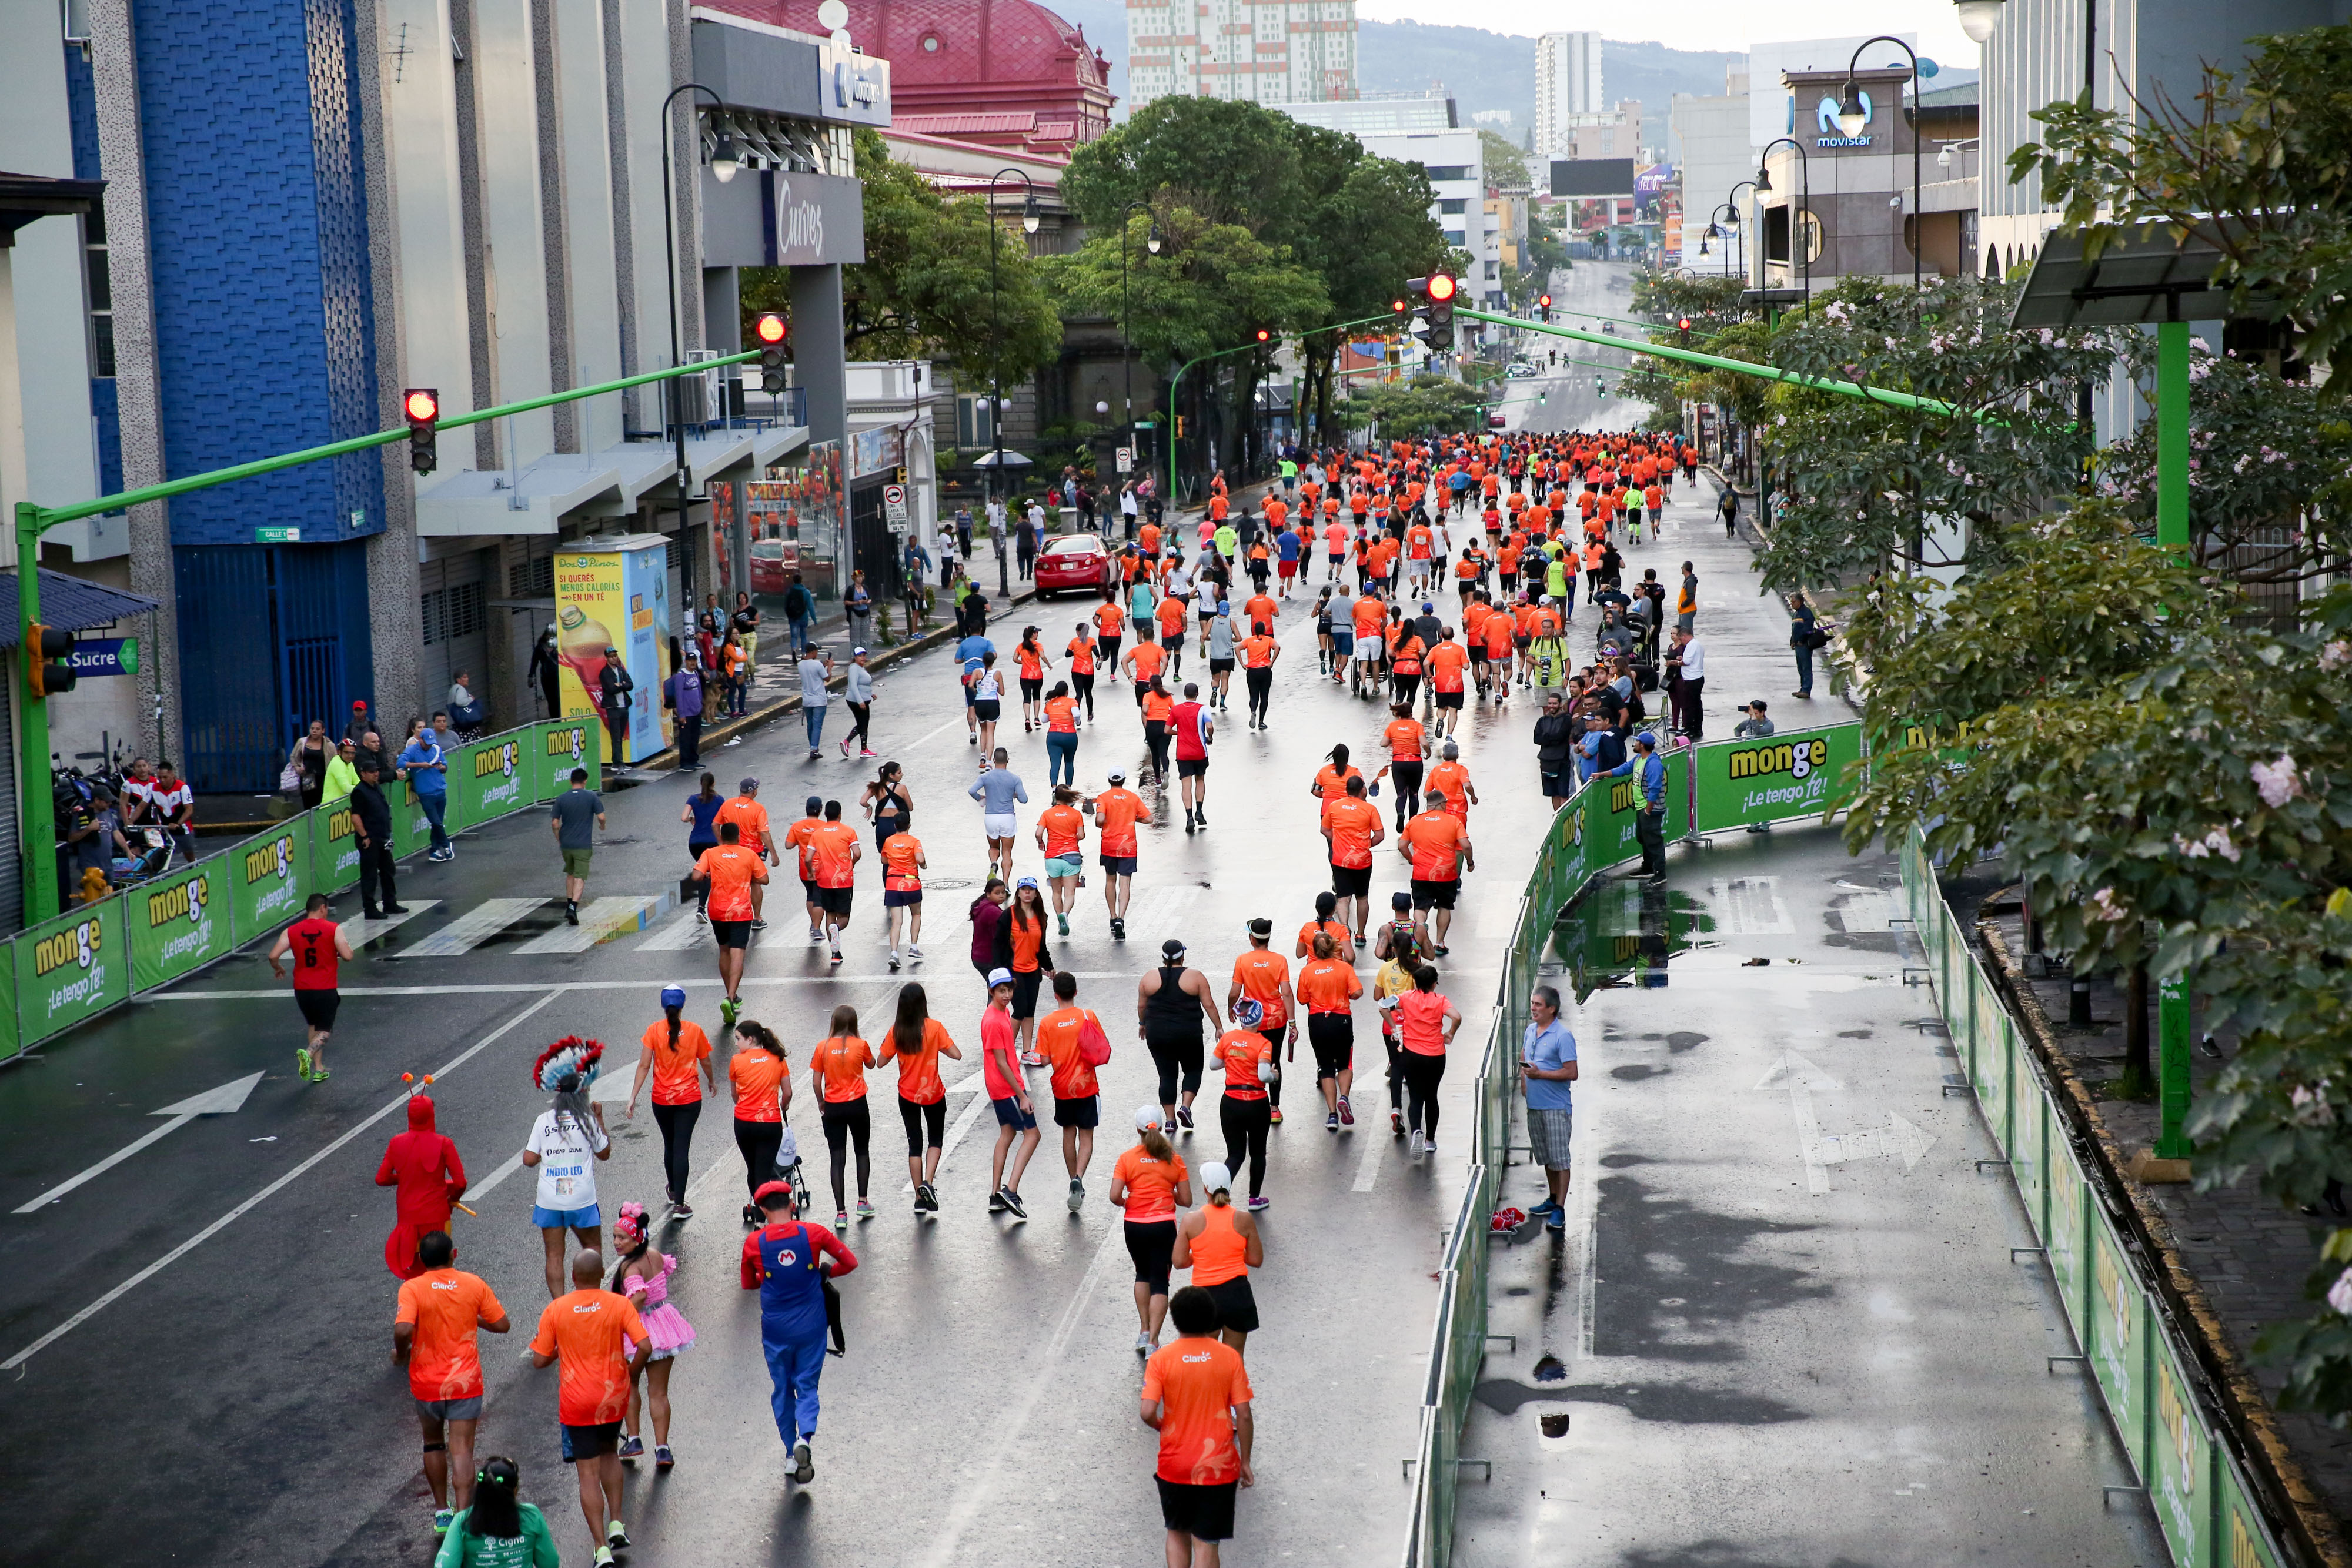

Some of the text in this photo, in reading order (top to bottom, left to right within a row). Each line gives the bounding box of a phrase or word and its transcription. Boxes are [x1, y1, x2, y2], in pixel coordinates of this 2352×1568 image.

[1818, 136, 1872, 147] movistar
[779, 179, 823, 257] Curves
[559, 557, 619, 567] Dos Pinos
[560, 581, 620, 591] MENOS CALORÍAS
[568, 573, 594, 582] QUERÉS
[597, 592, 604, 601] TÉ
[72, 651, 116, 667] Sucre
[569, 708, 591, 717] SOLO
[547, 727, 586, 761] monge
[476, 740, 519, 778] monge
[1730, 738, 1826, 780] monge
[492, 782, 509, 800] tengo
[1742, 771, 1828, 813] ¡Le tengo fe!
[246, 834, 294, 885] monge
[345, 850, 360, 866] teng
[149, 874, 208, 928] monge
[266, 886, 285, 908] tengo
[35, 917, 101, 977] monge
[173, 931, 198, 952] tengo
[305, 947, 317, 968] 6
[48, 989, 62, 1018] ¡Le
[63, 978, 88, 1004] tengo
[546, 1165, 583, 1176] INDIO LEO
[780, 1251, 794, 1263] M
[432, 1282, 455, 1290] Claro
[2098, 1235, 2130, 1350] monge
[573, 1303, 598, 1313] Claro
[1182, 1353, 1209, 1363] Claro
[2159, 1358, 2195, 1497] monge
[499, 1536, 525, 1547] Cigna
